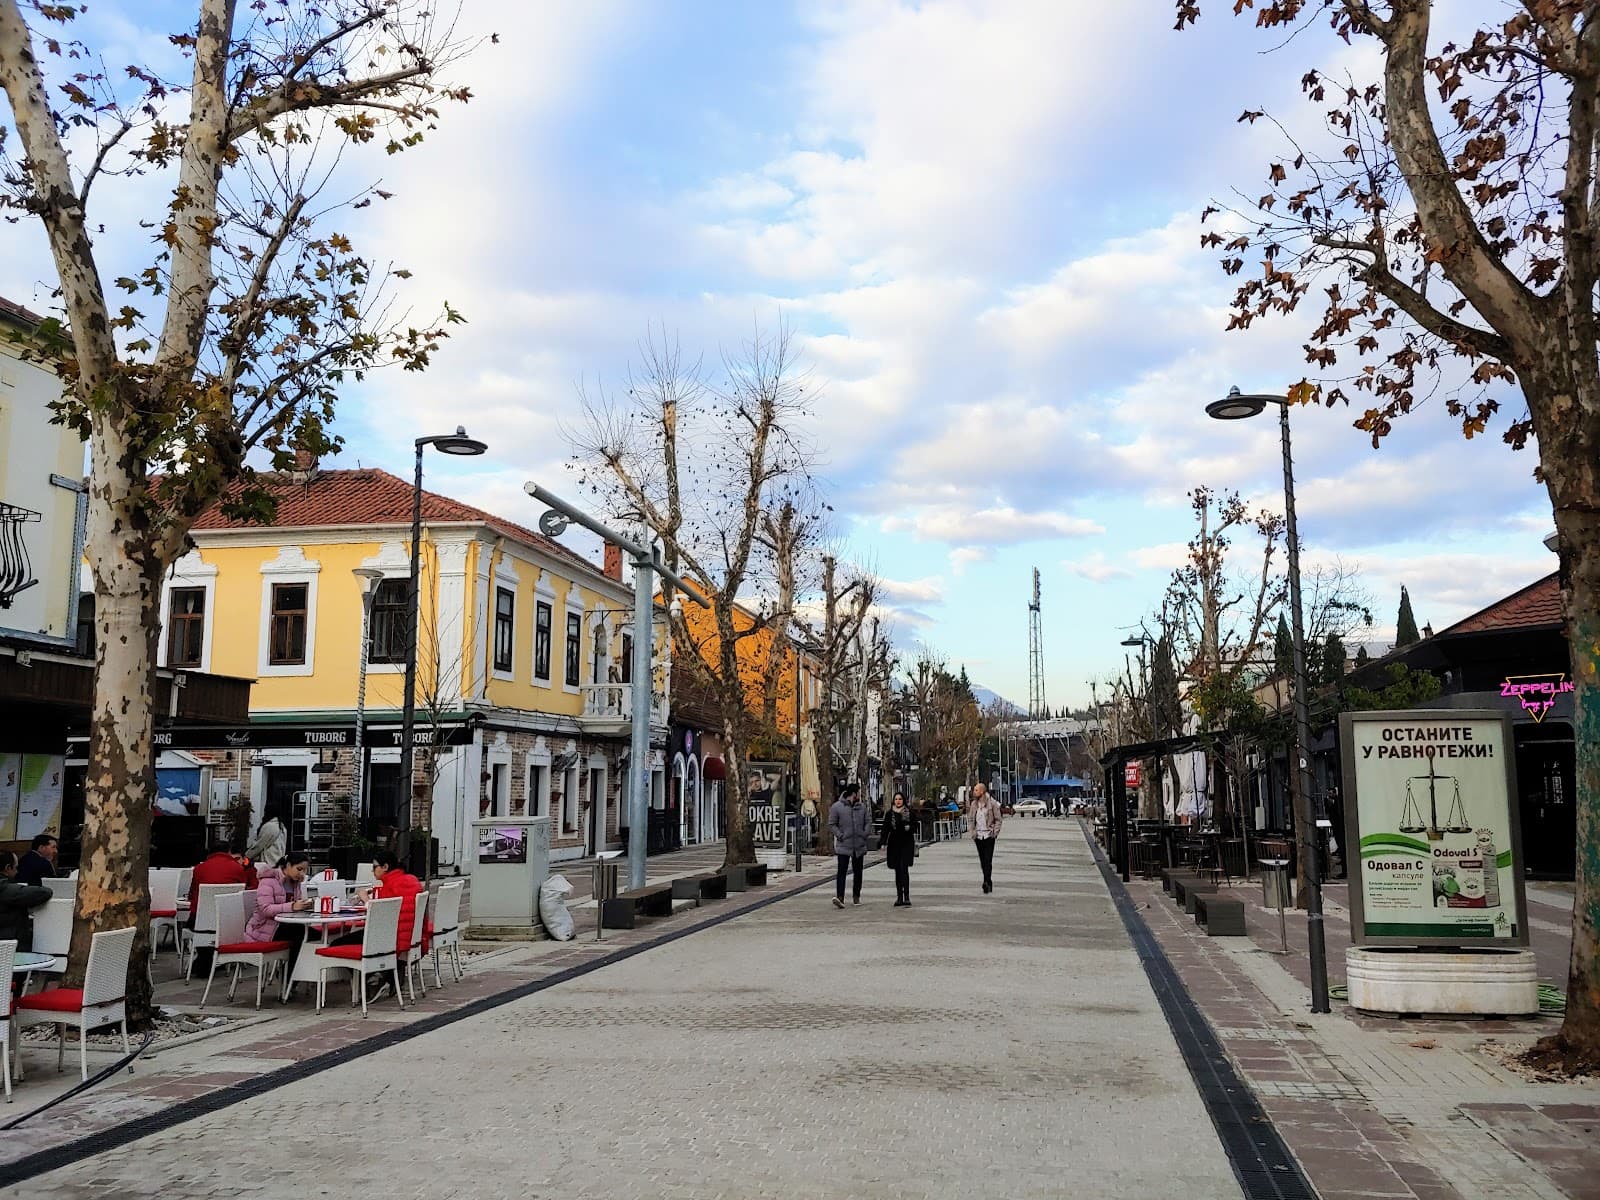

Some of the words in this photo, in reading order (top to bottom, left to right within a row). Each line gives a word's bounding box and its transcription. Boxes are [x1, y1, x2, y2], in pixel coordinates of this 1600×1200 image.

[1500, 682, 1575, 696] ZEPPELIN
[304, 732, 347, 743] TUBORG
[392, 732, 434, 744] TOR
[1382, 727, 1473, 741] ОСТАНИТЕ
[1362, 745, 1373, 758] У
[1378, 744, 1493, 758] РАВНОТЕЖИ!
[752, 823, 780, 841] AVE
[1433, 848, 1470, 857] Odoval
[1368, 860, 1412, 871] Одовал
